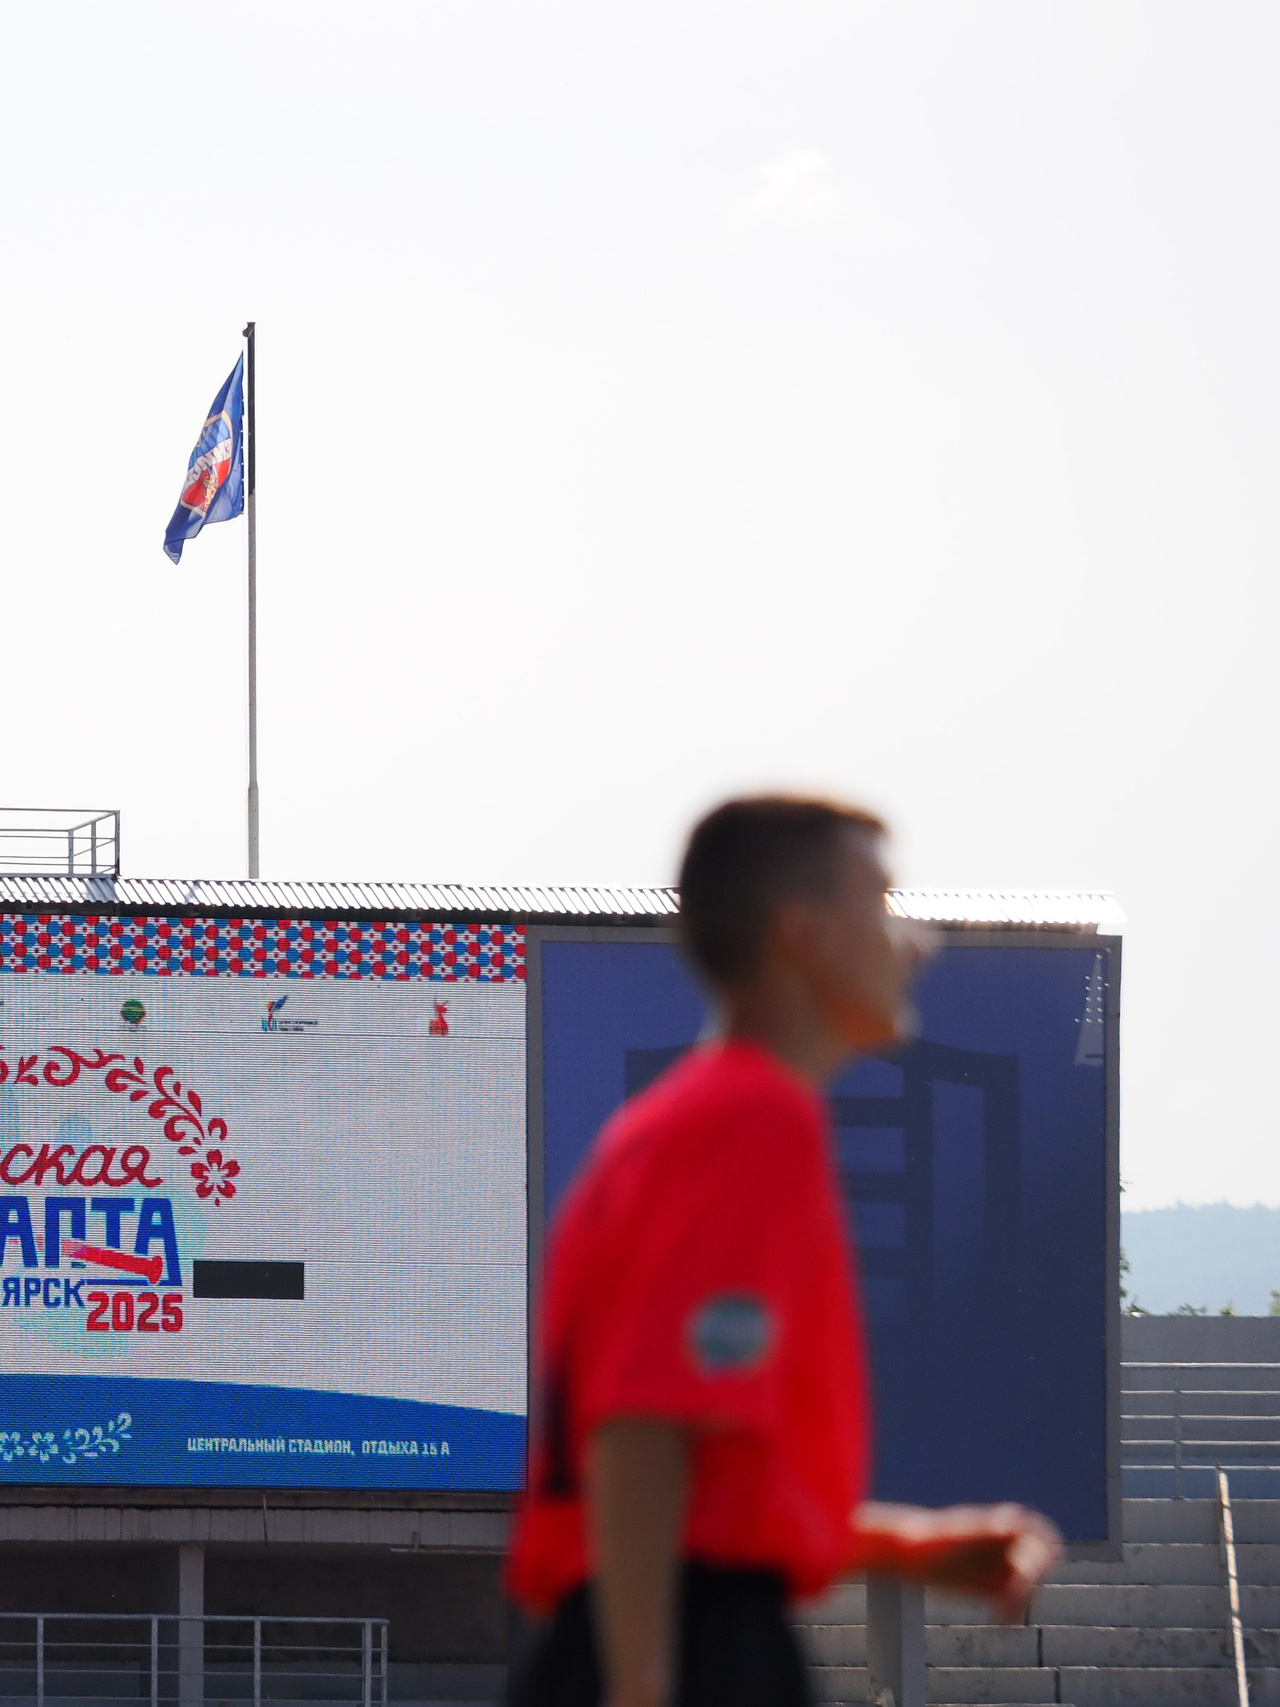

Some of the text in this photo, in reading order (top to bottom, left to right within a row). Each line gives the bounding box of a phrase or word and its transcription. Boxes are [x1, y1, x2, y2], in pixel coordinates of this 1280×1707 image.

[86, 1292, 183, 1332] 2025
[187, 1436, 286, 1453] ЦЕНТРАЛЬНЫЙ
[361, 1439, 418, 1456] ОТДЫХА
